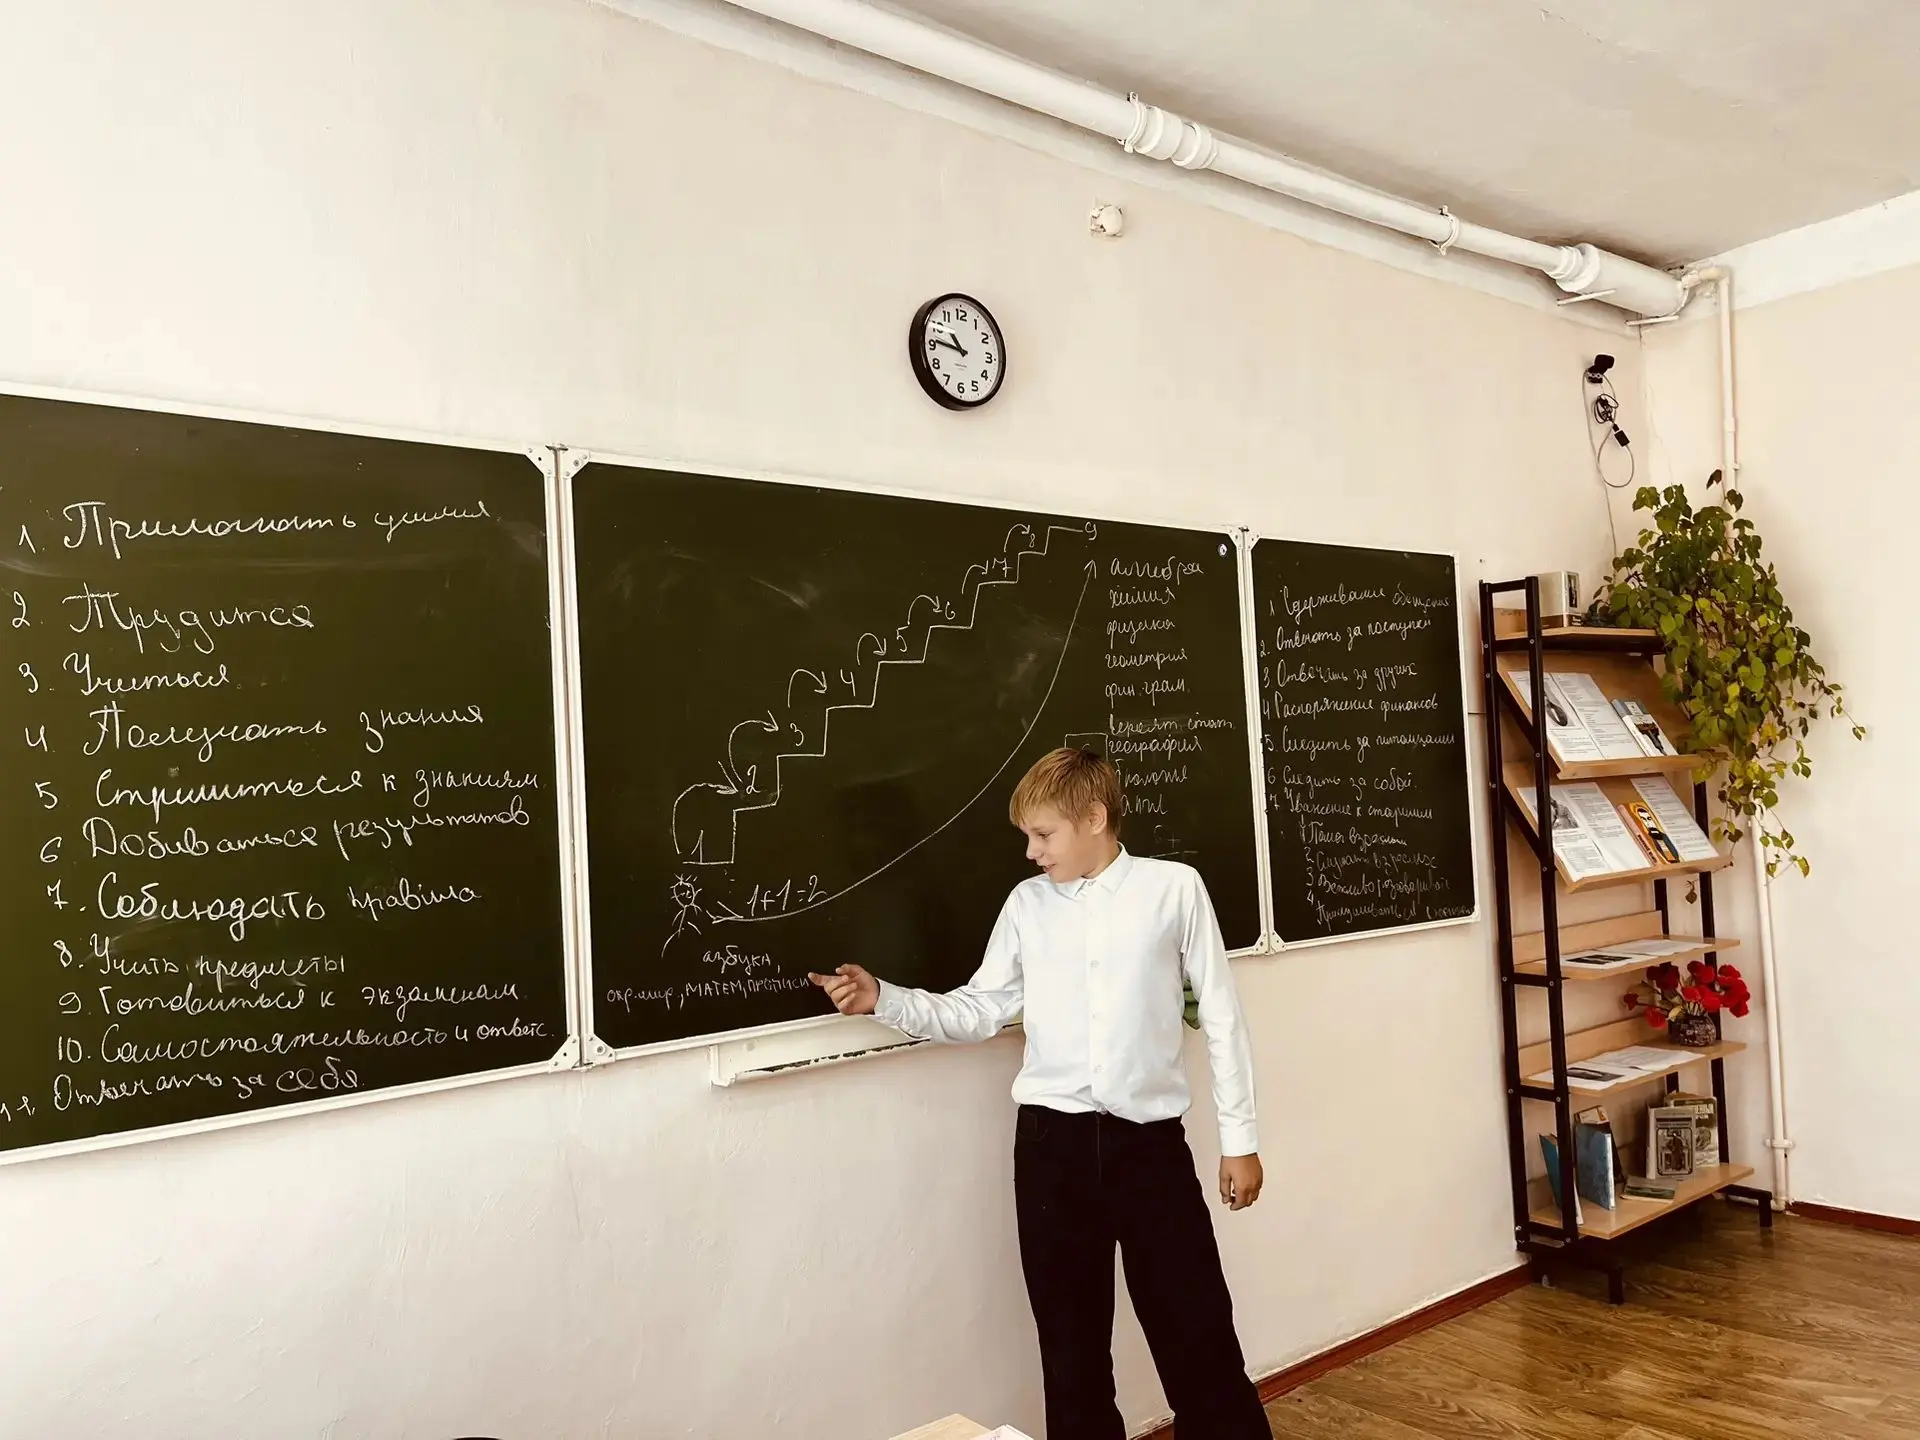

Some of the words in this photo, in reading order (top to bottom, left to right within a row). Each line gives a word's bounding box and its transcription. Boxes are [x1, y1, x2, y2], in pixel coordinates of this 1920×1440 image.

[942, 310, 951, 323] 11
[955, 308, 967, 322] 12
[973, 318, 978, 331] 1
[928, 338, 936, 351] 9
[980, 332, 989, 344] 2
[932, 358, 940, 370] 8
[985, 352, 993, 364] 3
[942, 373, 951, 386] 7
[971, 380, 979, 392] 5
[980, 369, 988, 381] 4
[957, 382, 965, 394] 6
[1028, 533, 1036, 548] 8
[1084, 521, 1098, 541] 9
[992, 557, 1013, 578] 7
[61, 581, 315, 655] Трудится
[944, 601, 956, 620] 6
[896, 625, 909, 652] 5
[1106, 618, 1175, 650] физика
[1346, 626, 1363, 652] за
[1367, 618, 1432, 641] поступки
[1104, 648, 1188, 671] геометрия
[840, 668, 857, 698] 4
[1353, 668, 1368, 690] за
[1374, 663, 1418, 692] других
[359, 704, 484, 754] знания
[789, 722, 805, 747] 3
[1356, 734, 1370, 764] за
[381, 772, 398, 793] к
[745, 764, 761, 794] 2
[1350, 777, 1367, 801] за
[333, 795, 531, 862] результатов
[690, 829, 704, 864] 1
[98, 871, 326, 943] Соблюдать
[746, 874, 828, 917] 1+1=2
[196, 954, 346, 993] предметы
[98, 982, 306, 1016] Готовиться
[320, 990, 337, 1008] к
[101, 1023, 448, 1064] Самостоятельность
[454, 1025, 468, 1042] и
[231, 1073, 268, 1100] за
